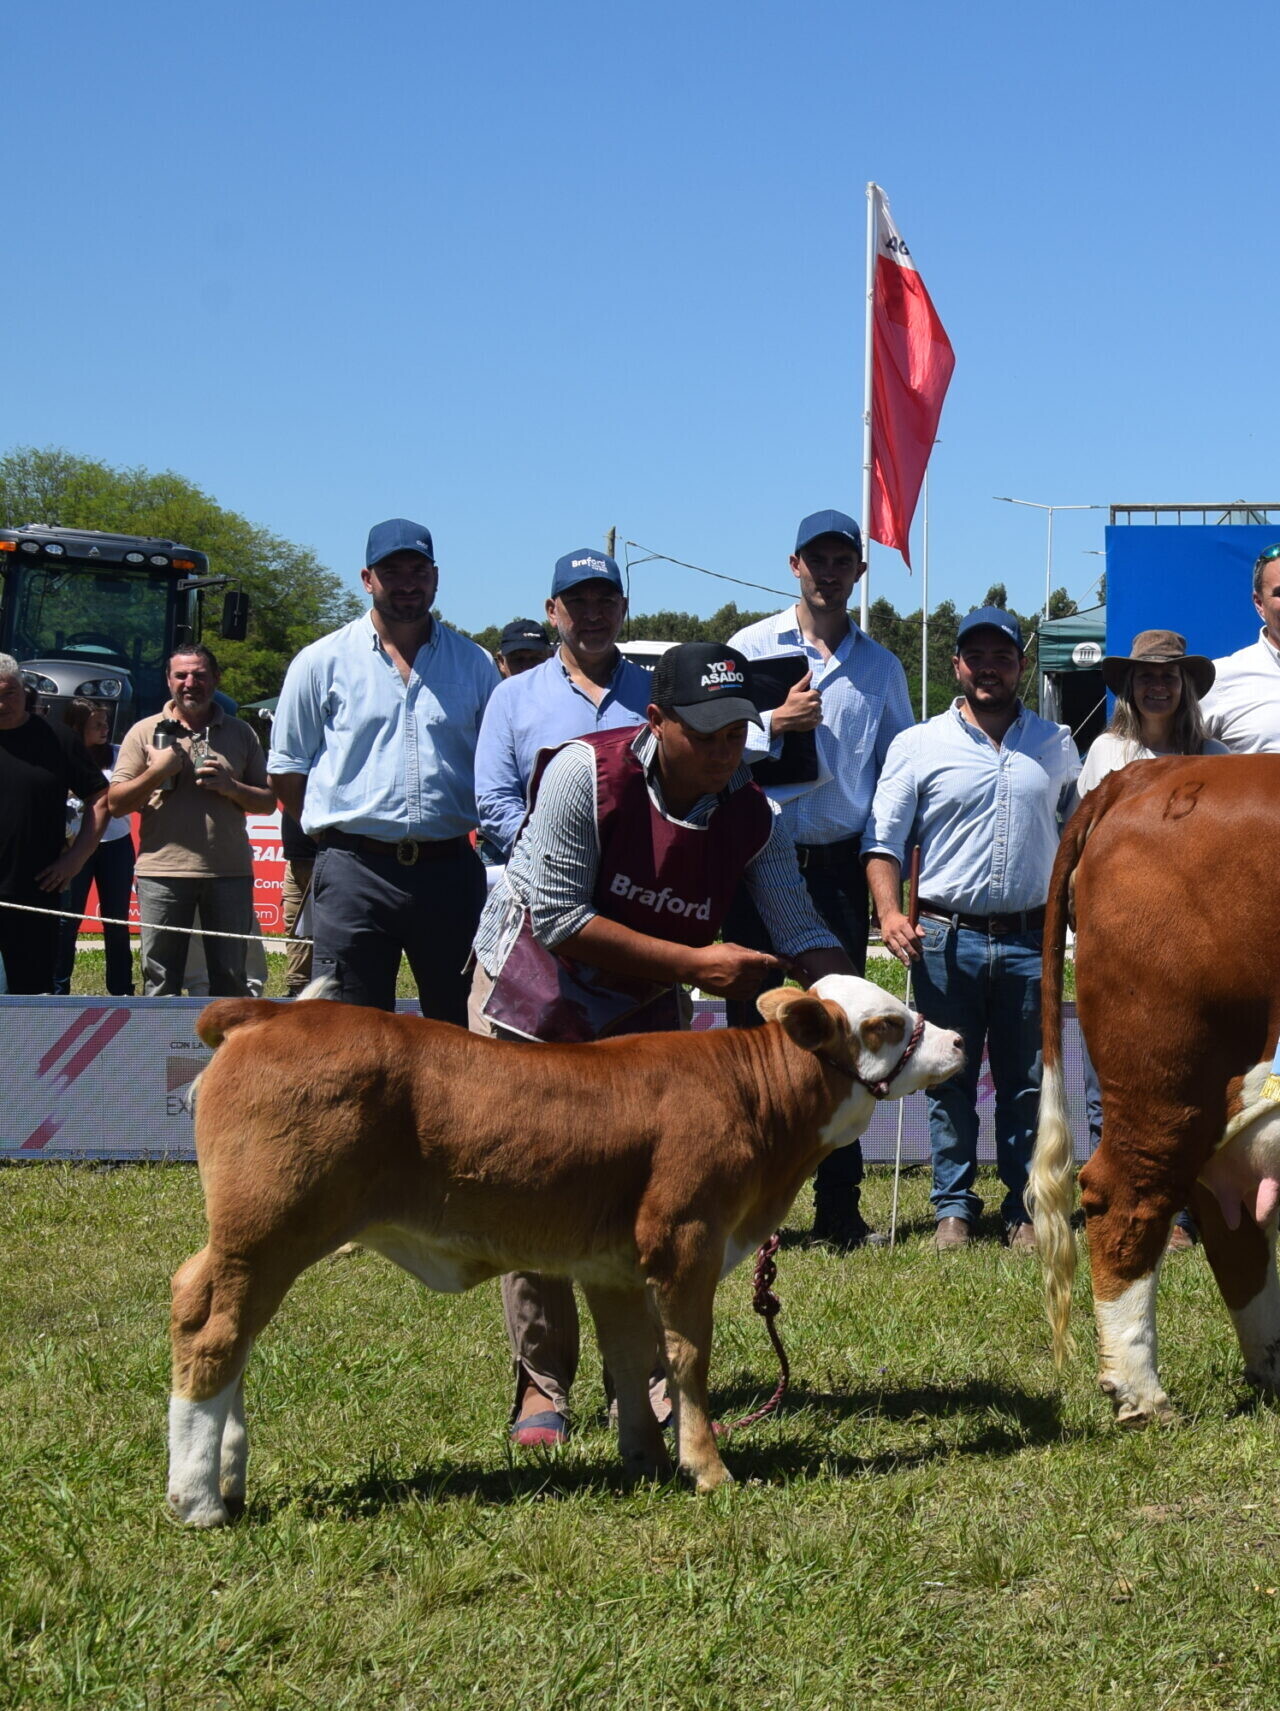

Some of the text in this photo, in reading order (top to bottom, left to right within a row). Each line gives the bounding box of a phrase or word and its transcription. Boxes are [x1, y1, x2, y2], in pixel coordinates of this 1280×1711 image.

[571, 556, 606, 568] Braford
[706, 661, 727, 673] YO
[701, 671, 744, 687] ASADO
[610, 872, 712, 921] Braford
